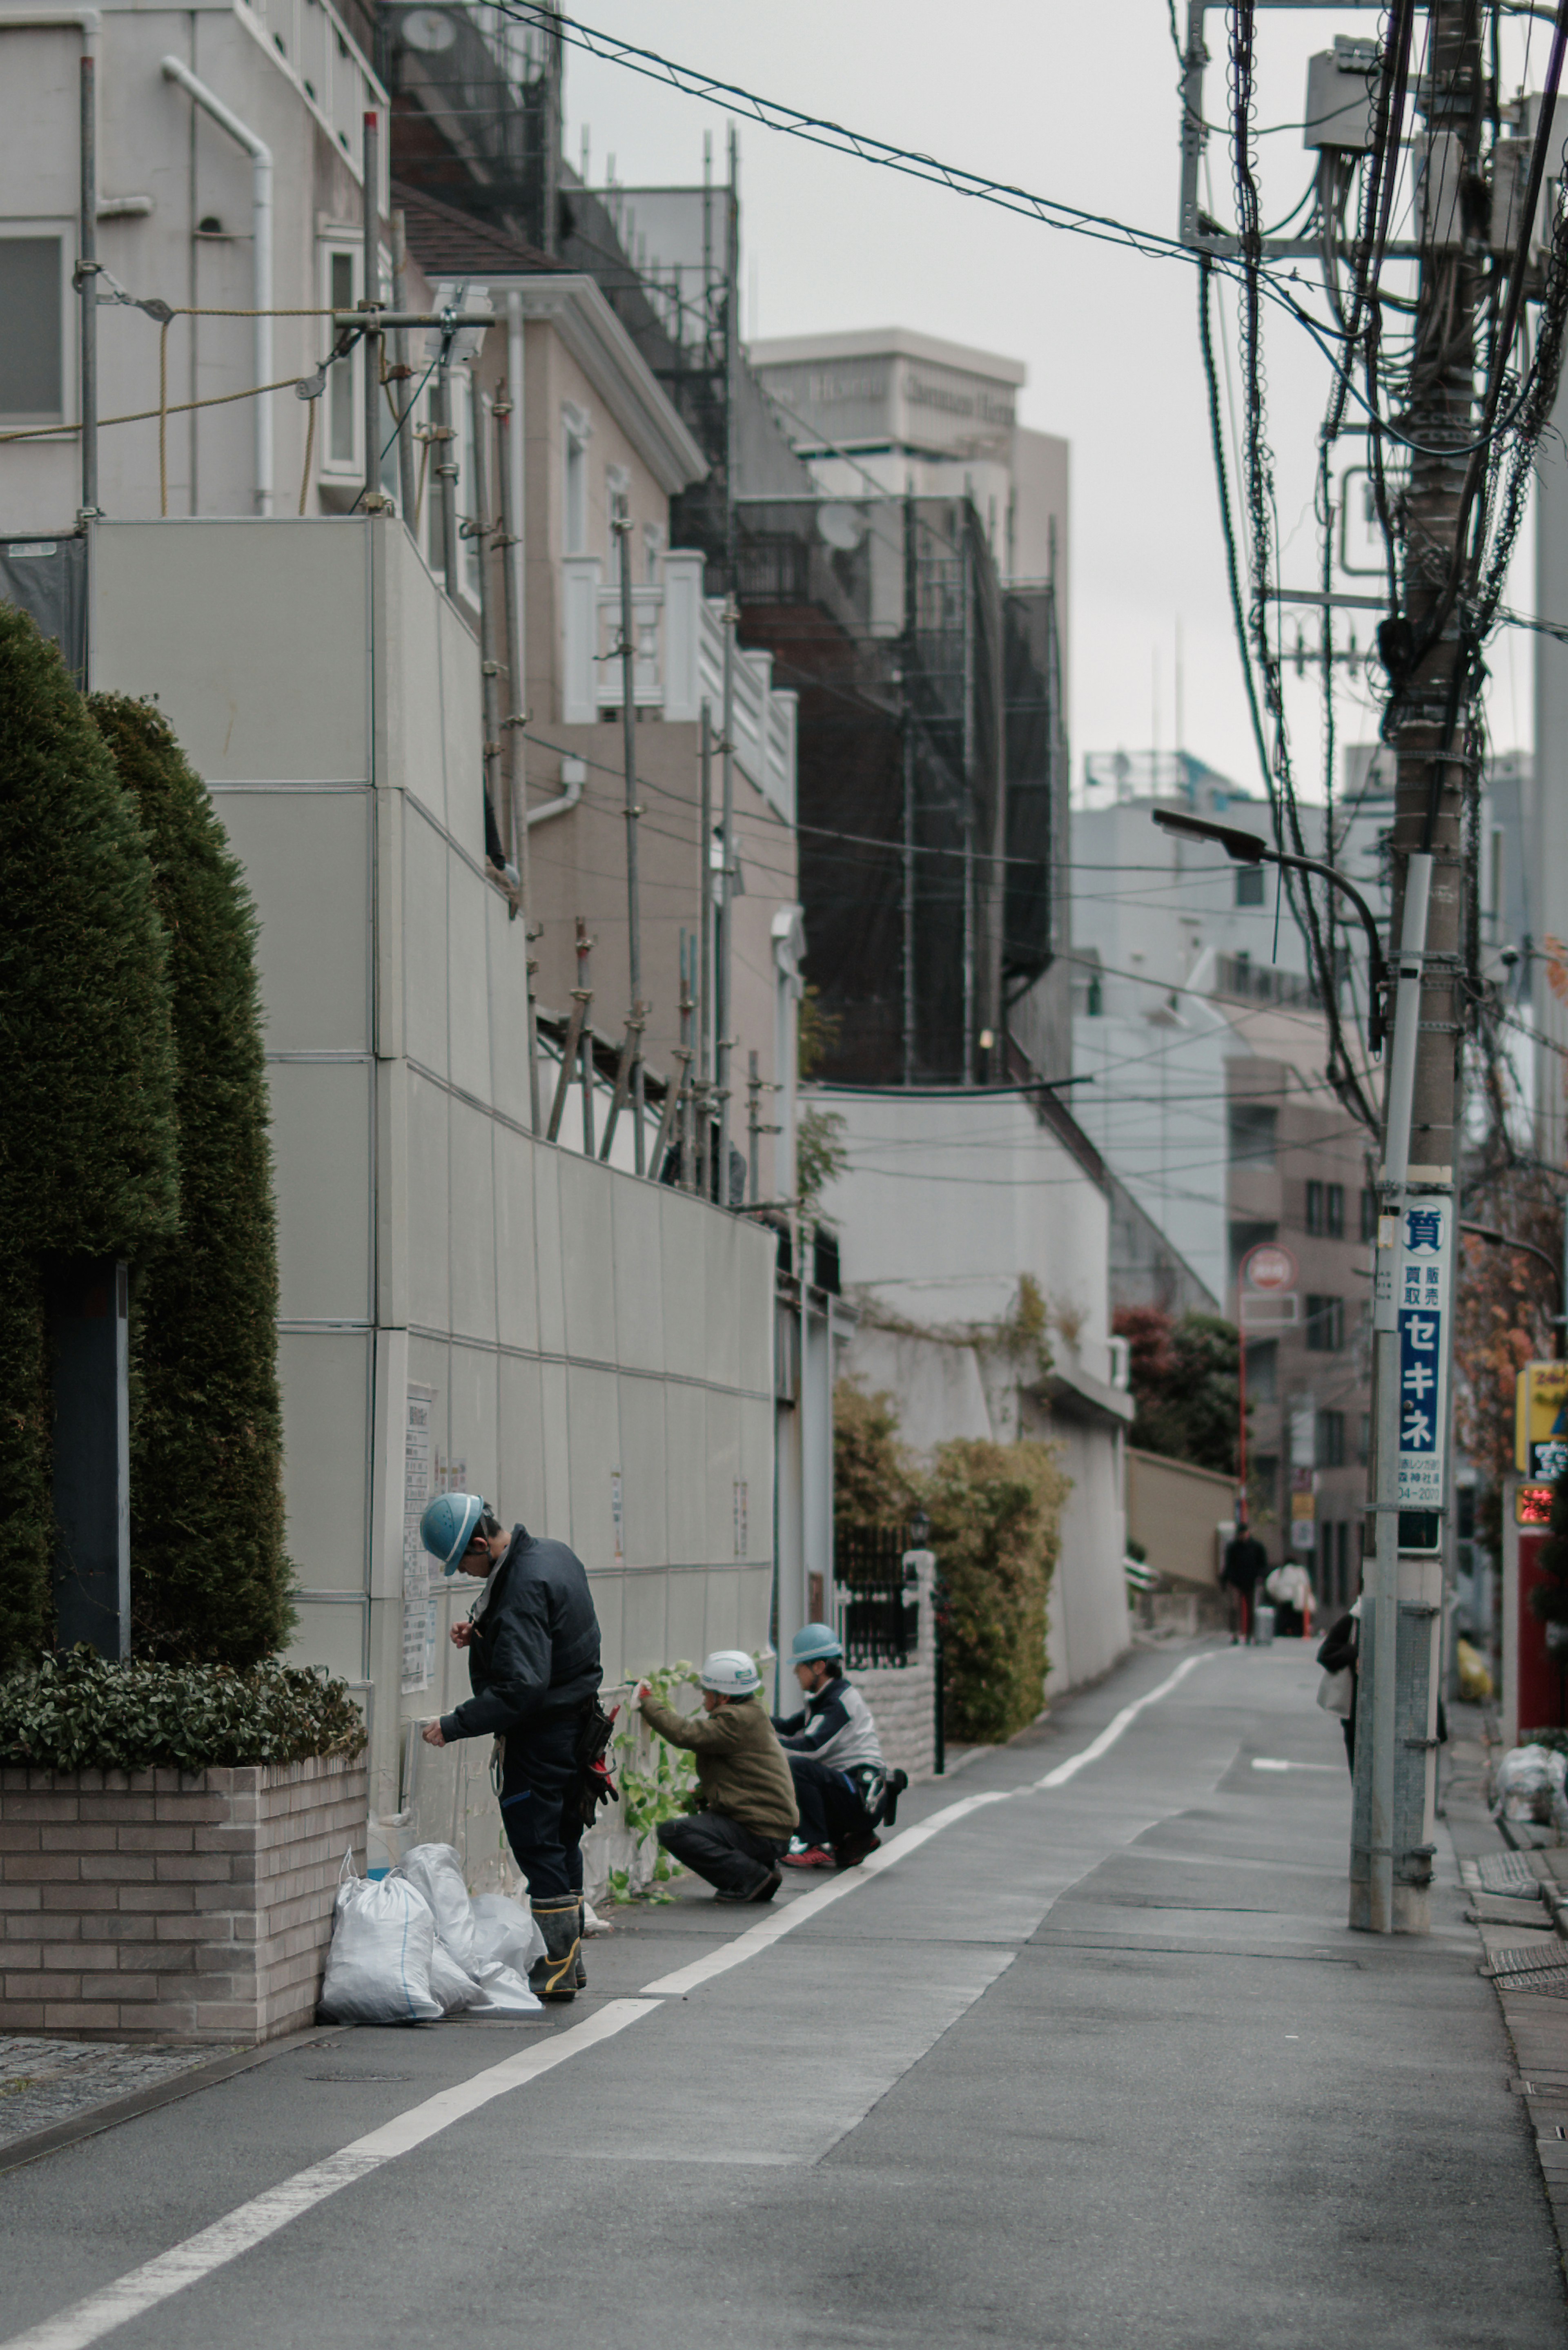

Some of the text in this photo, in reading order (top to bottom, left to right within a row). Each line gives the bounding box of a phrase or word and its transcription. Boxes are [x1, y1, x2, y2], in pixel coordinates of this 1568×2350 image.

[1407, 1210, 1441, 1251] 質
[1405, 1266, 1421, 1305] 買取
[1425, 1266, 1440, 1306] 販売
[1402, 1313, 1435, 1448] セキネ
